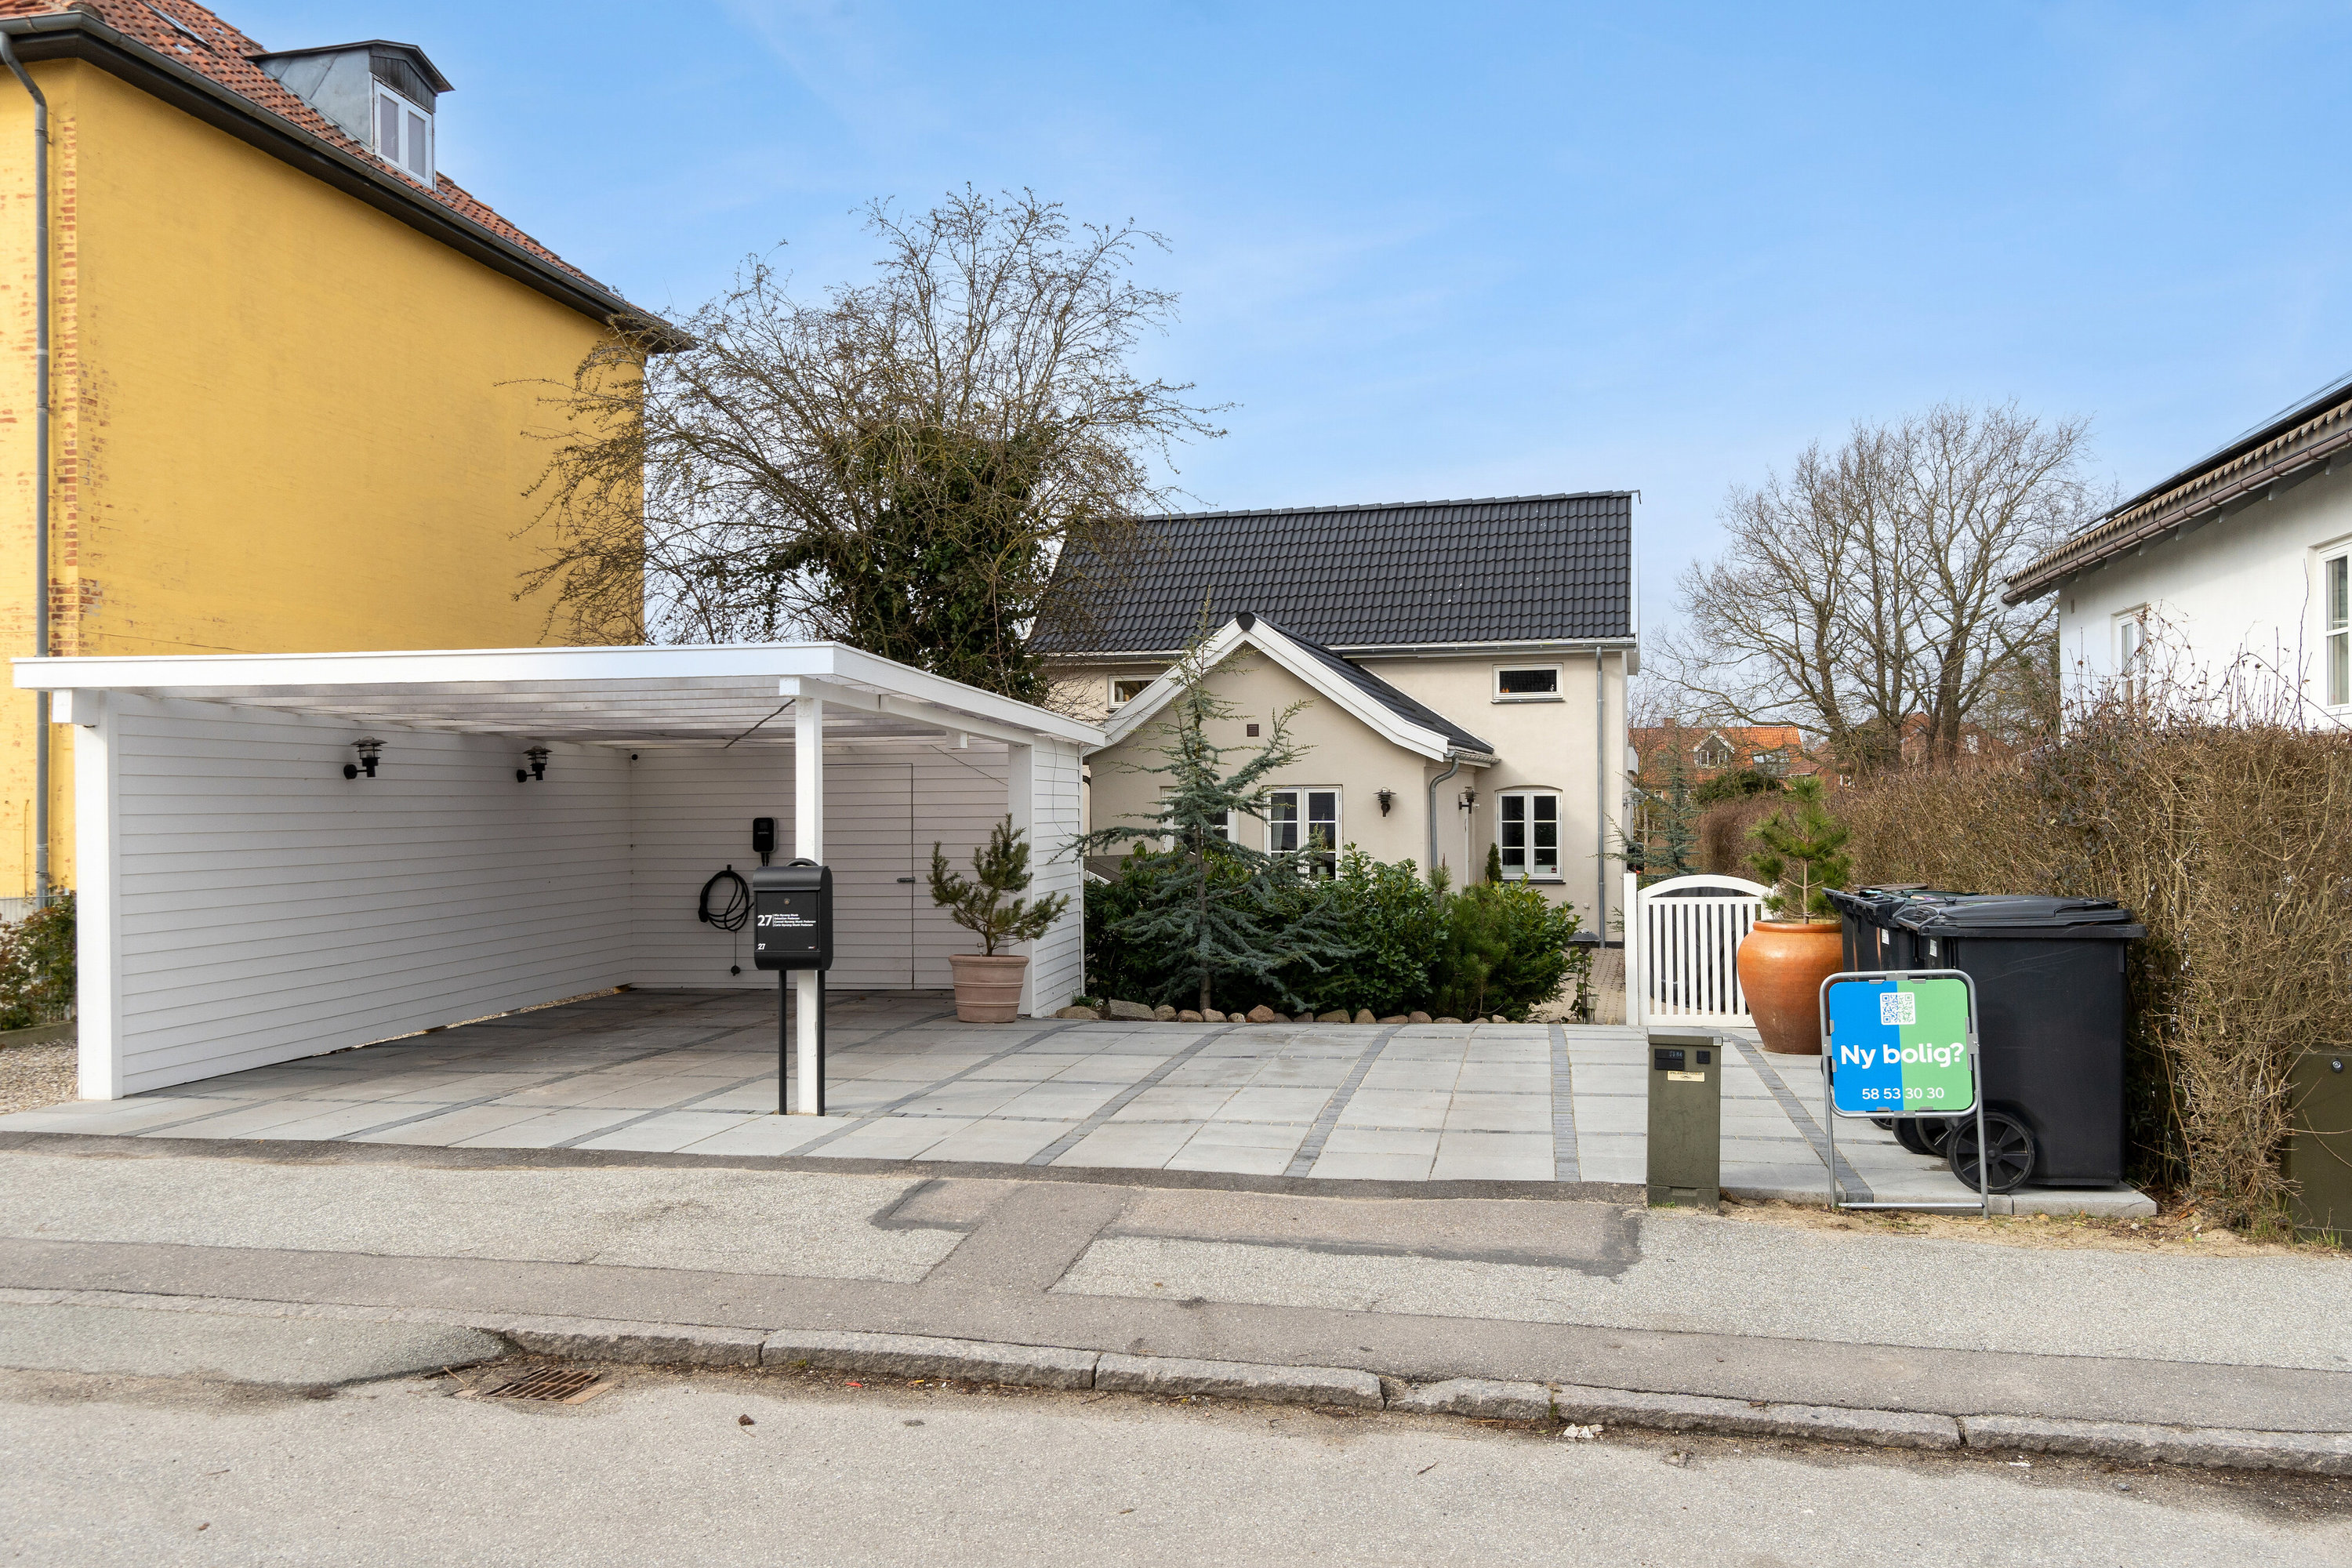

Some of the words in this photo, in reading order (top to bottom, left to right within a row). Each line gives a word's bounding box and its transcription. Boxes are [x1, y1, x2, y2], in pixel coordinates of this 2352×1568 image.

[757, 914, 772, 927] 27
[1840, 1044, 1877, 1069] Ny
[1882, 1042, 1965, 1069] bolig?
[1862, 1088, 1880, 1100] 58
[1883, 1087, 1901, 1099] 53
[1905, 1087, 1923, 1099] 30
[1926, 1087, 1944, 1099] 30
